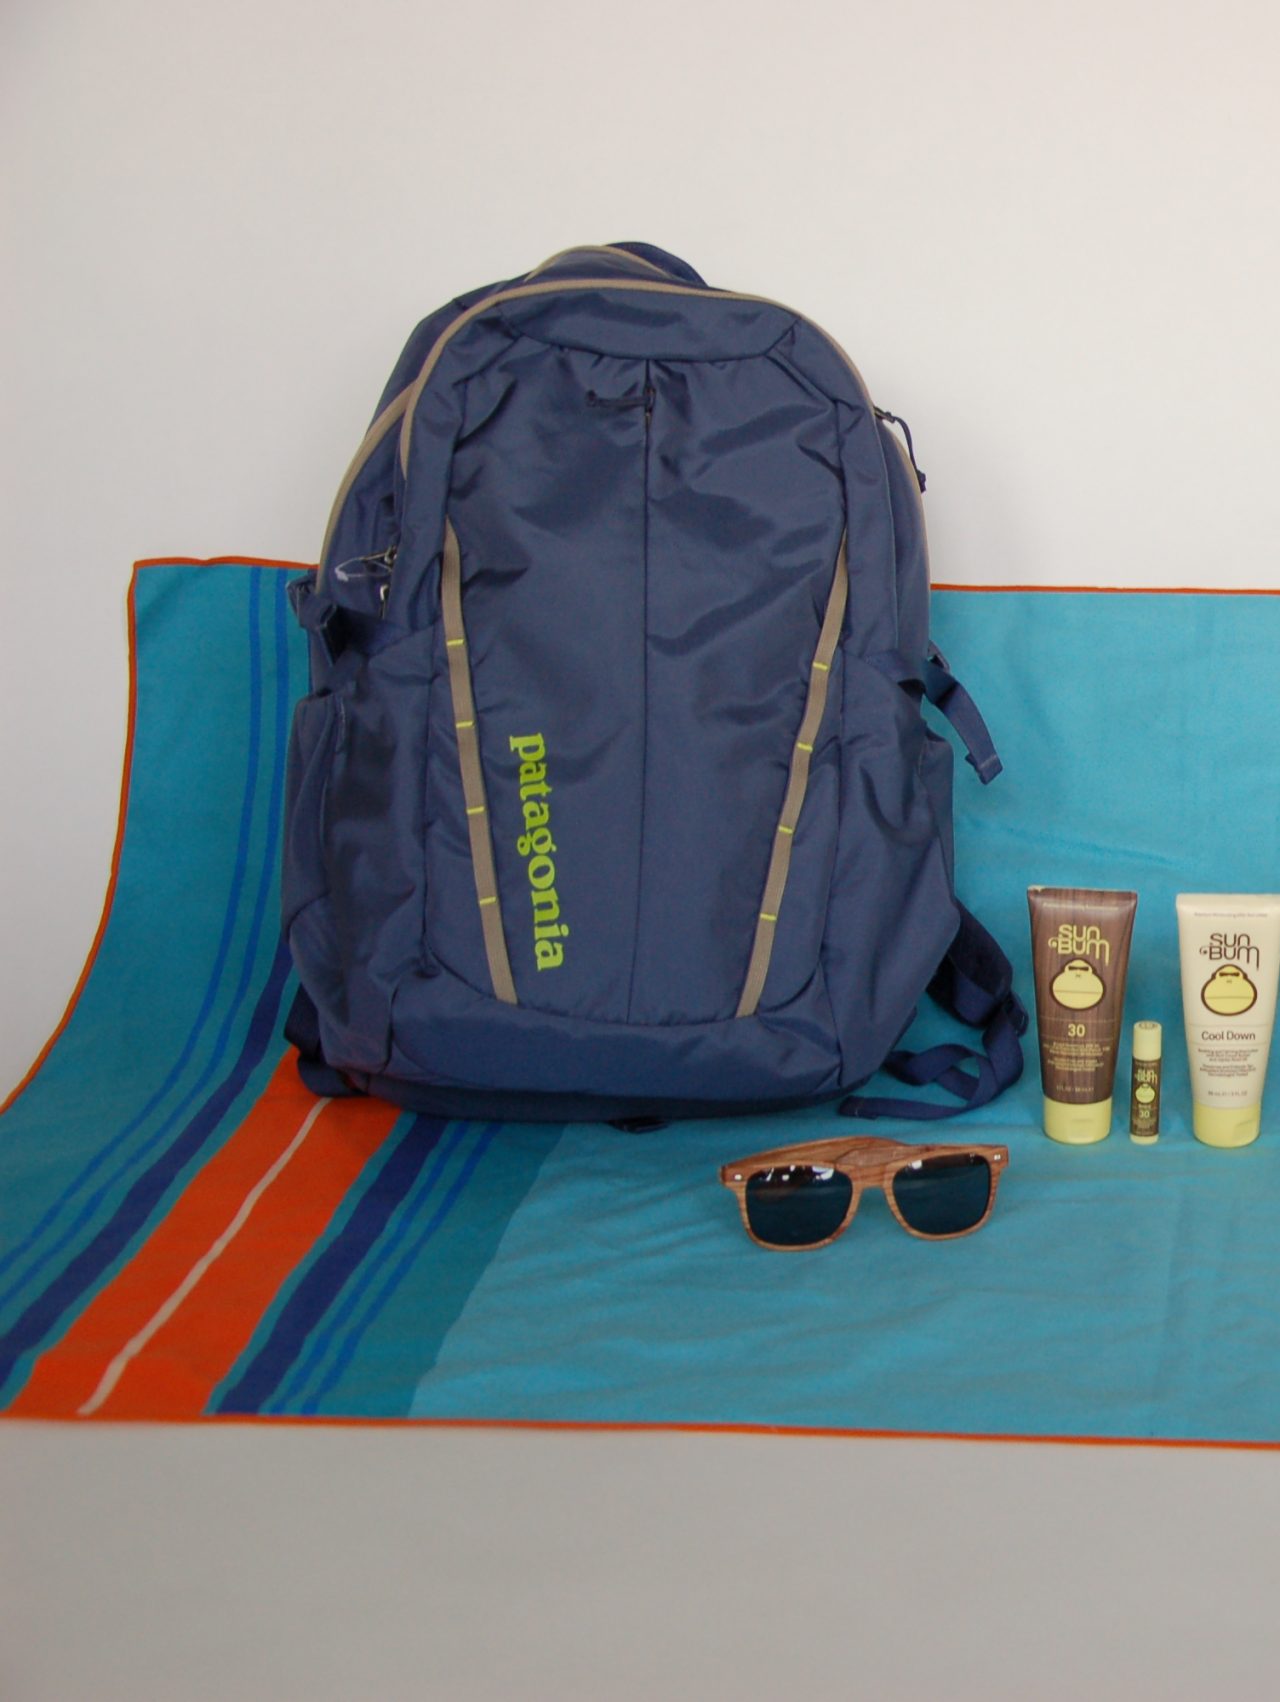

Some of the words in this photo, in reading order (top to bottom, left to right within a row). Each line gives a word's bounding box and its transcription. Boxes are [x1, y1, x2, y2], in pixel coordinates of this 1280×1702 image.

[508, 732, 570, 972] patagonia
[1067, 1023, 1086, 1037] 30
[1201, 1031, 1224, 1041] Cool
[1226, 1031, 1256, 1041] Down
